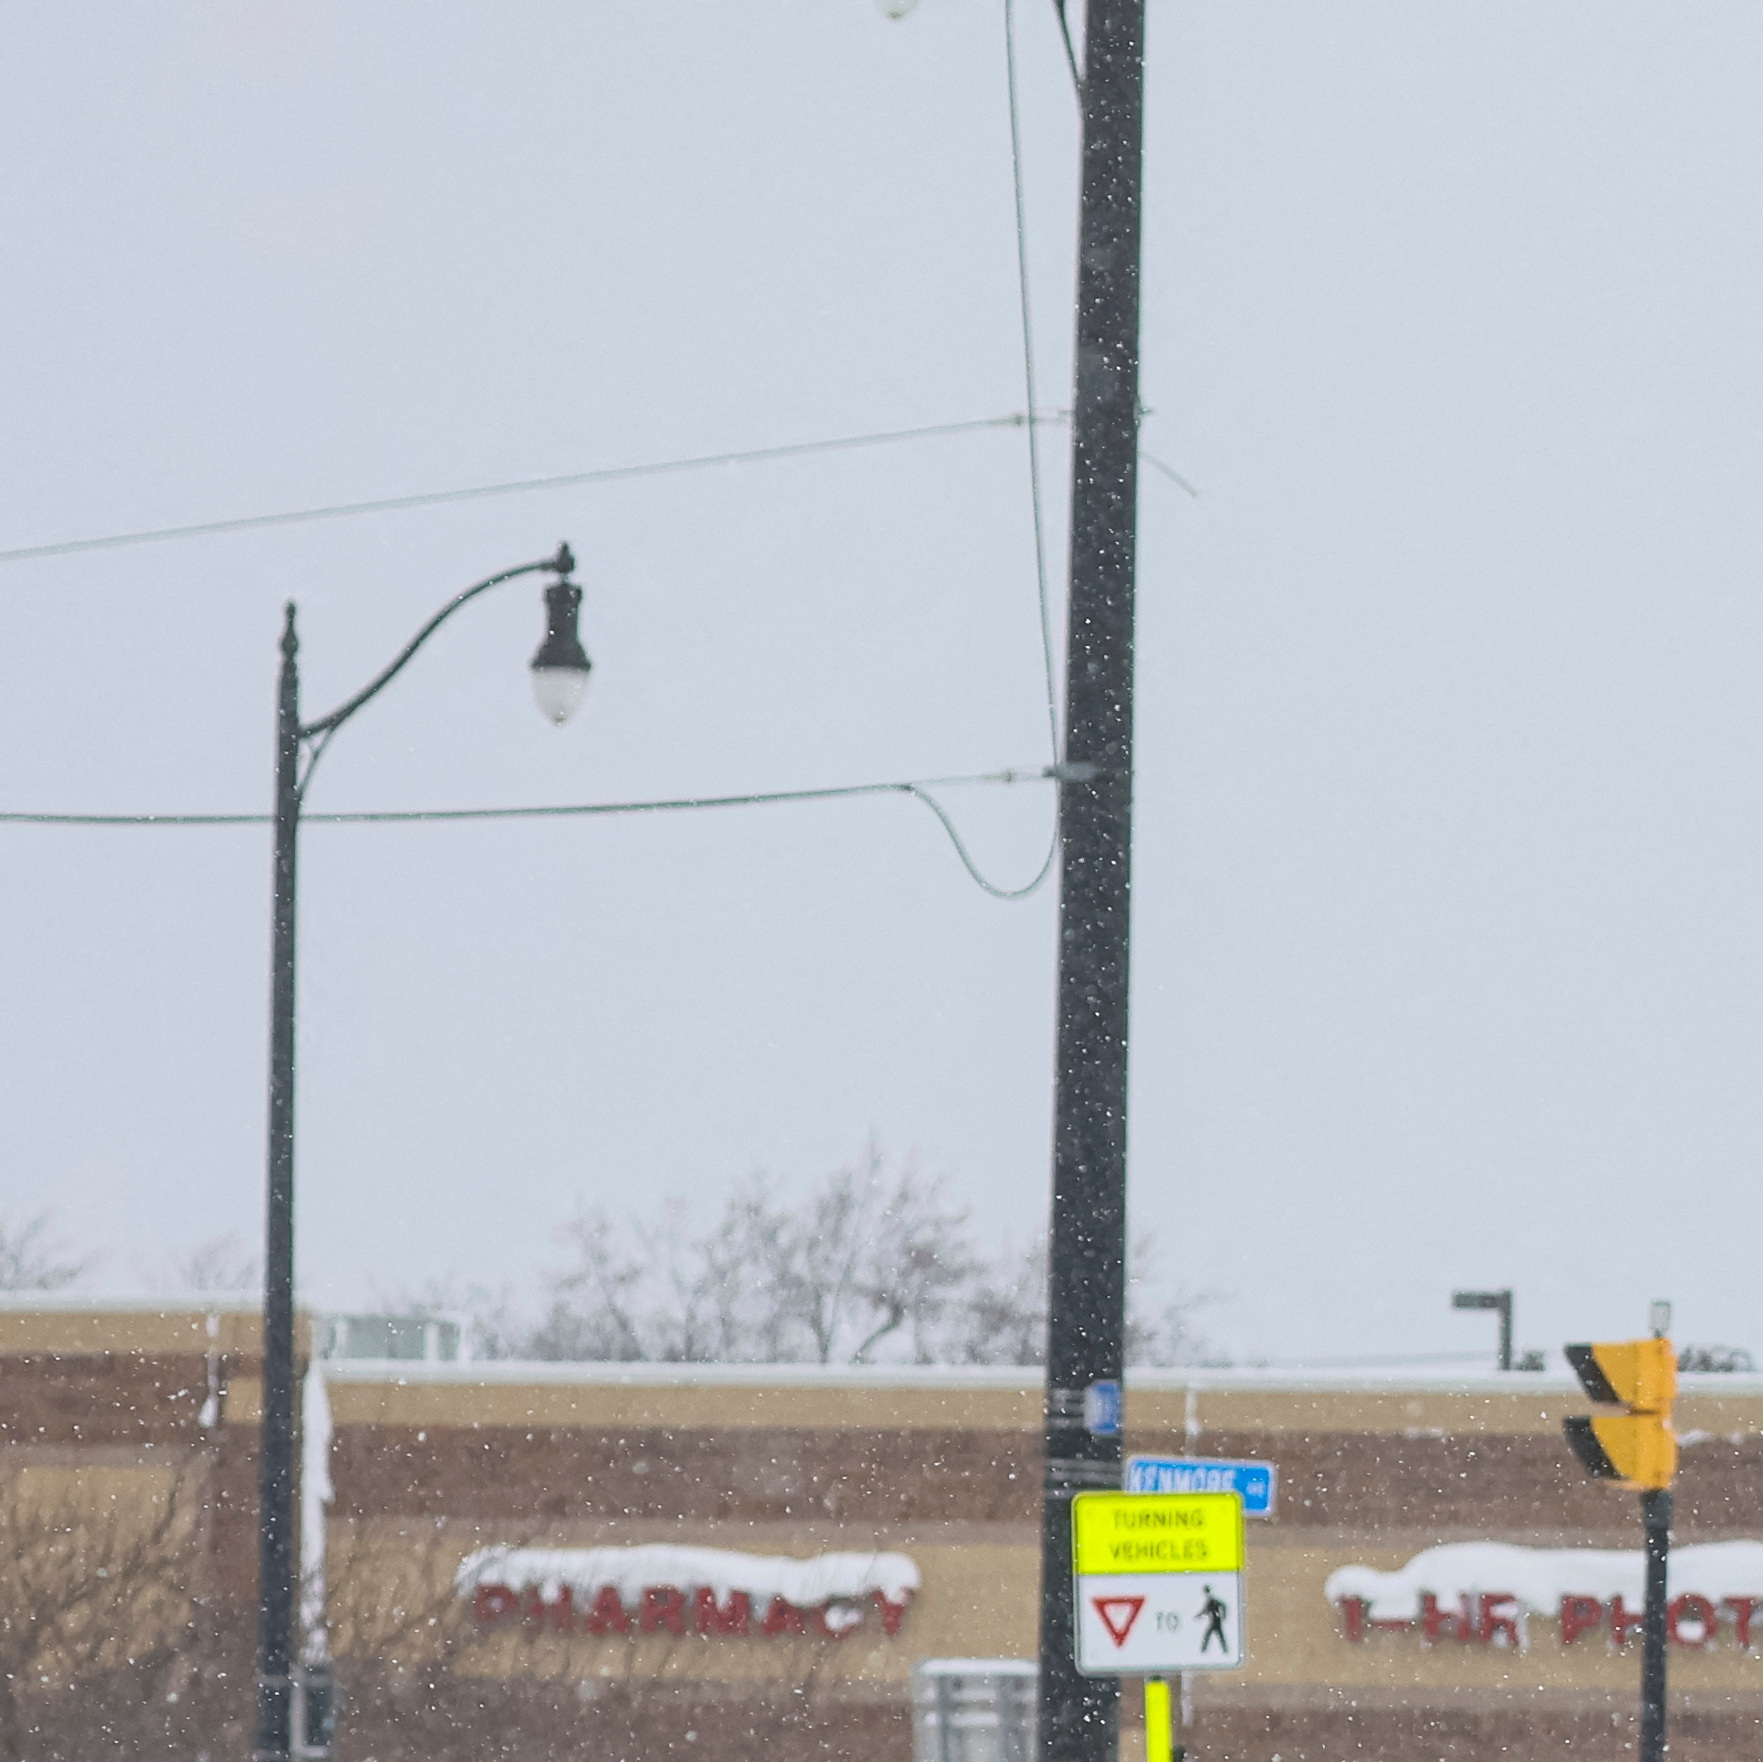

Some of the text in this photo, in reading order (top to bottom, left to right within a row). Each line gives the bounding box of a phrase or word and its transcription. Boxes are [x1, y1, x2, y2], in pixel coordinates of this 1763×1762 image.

[1113, 1508, 1206, 1531] TURNING
[1108, 1539, 1209, 1561] VEHICLES
[1156, 1611, 1180, 1632] TO
